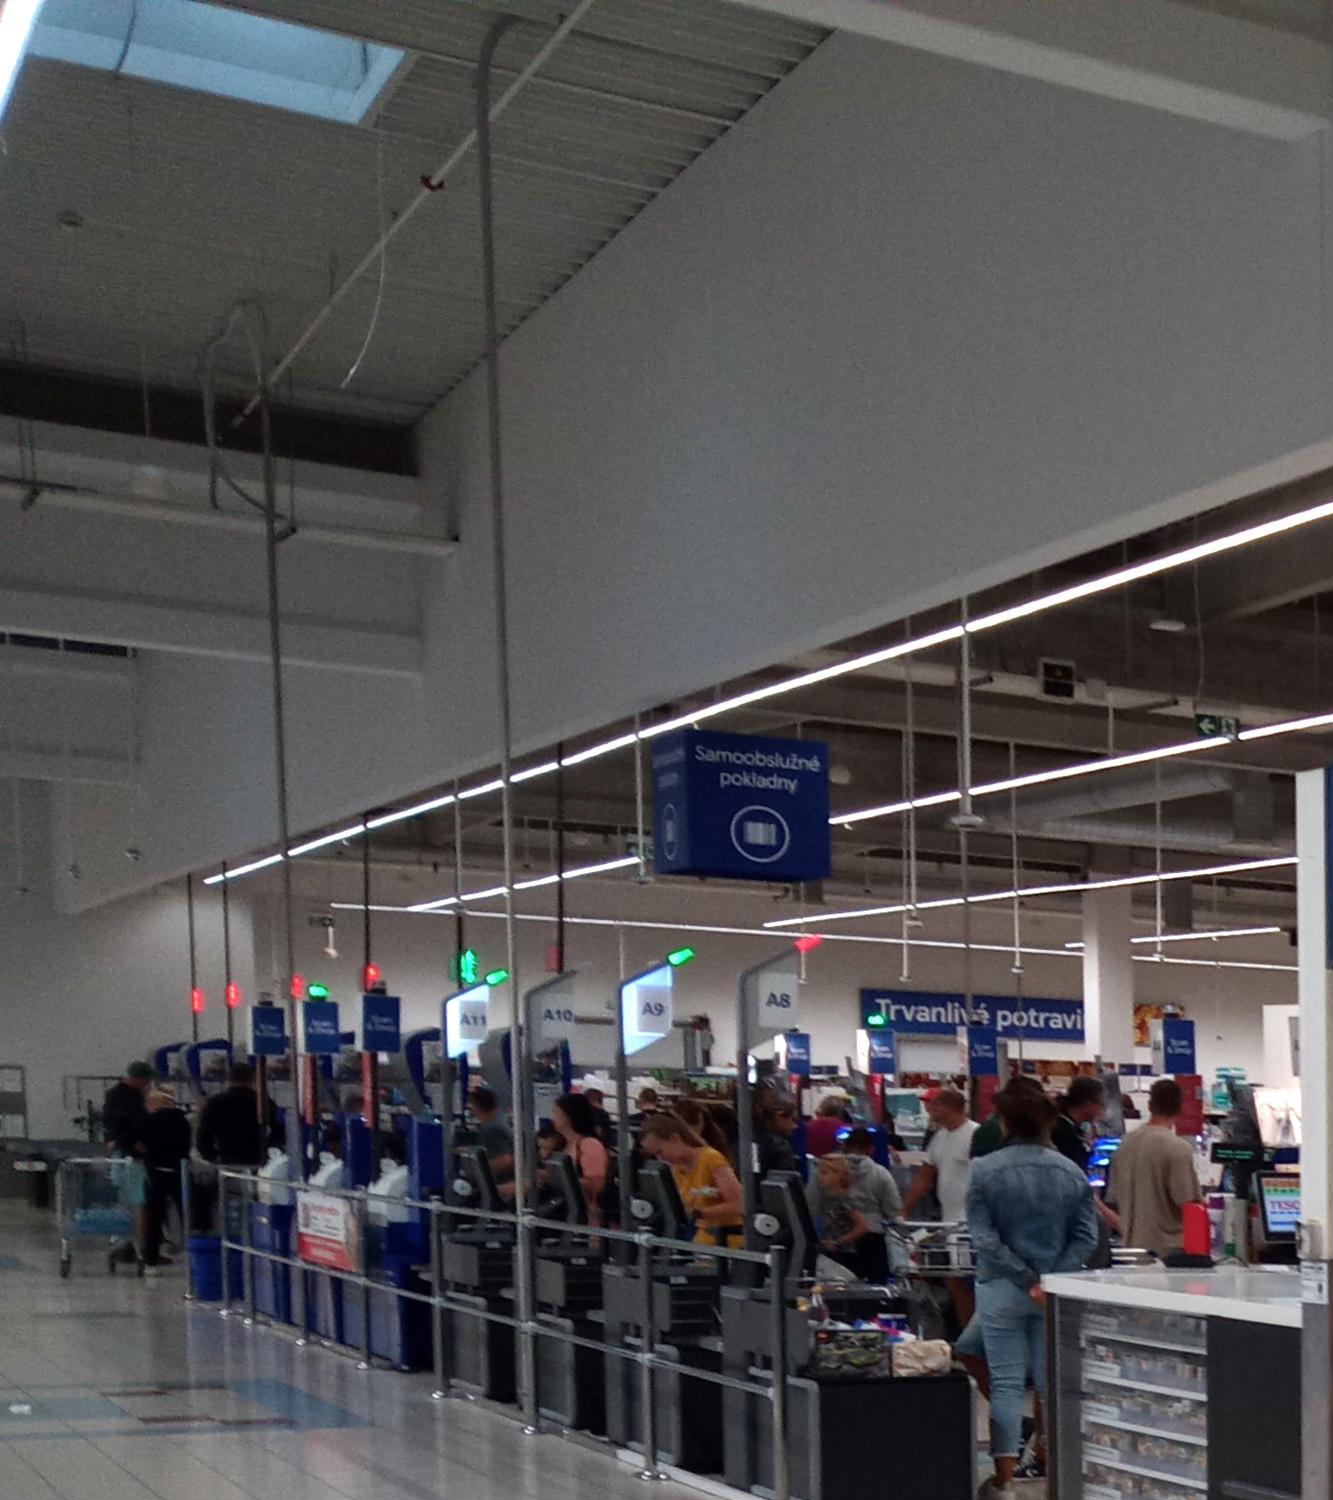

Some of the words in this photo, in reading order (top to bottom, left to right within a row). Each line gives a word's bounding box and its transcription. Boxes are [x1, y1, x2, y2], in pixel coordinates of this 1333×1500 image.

[694, 744, 822, 772] Samoobslužné
[719, 771, 799, 795] pokladny
[765, 991, 792, 1009] A8
[542, 1008, 574, 1022] A10
[641, 1001, 666, 1017] A9
[460, 1013, 488, 1027] A11
